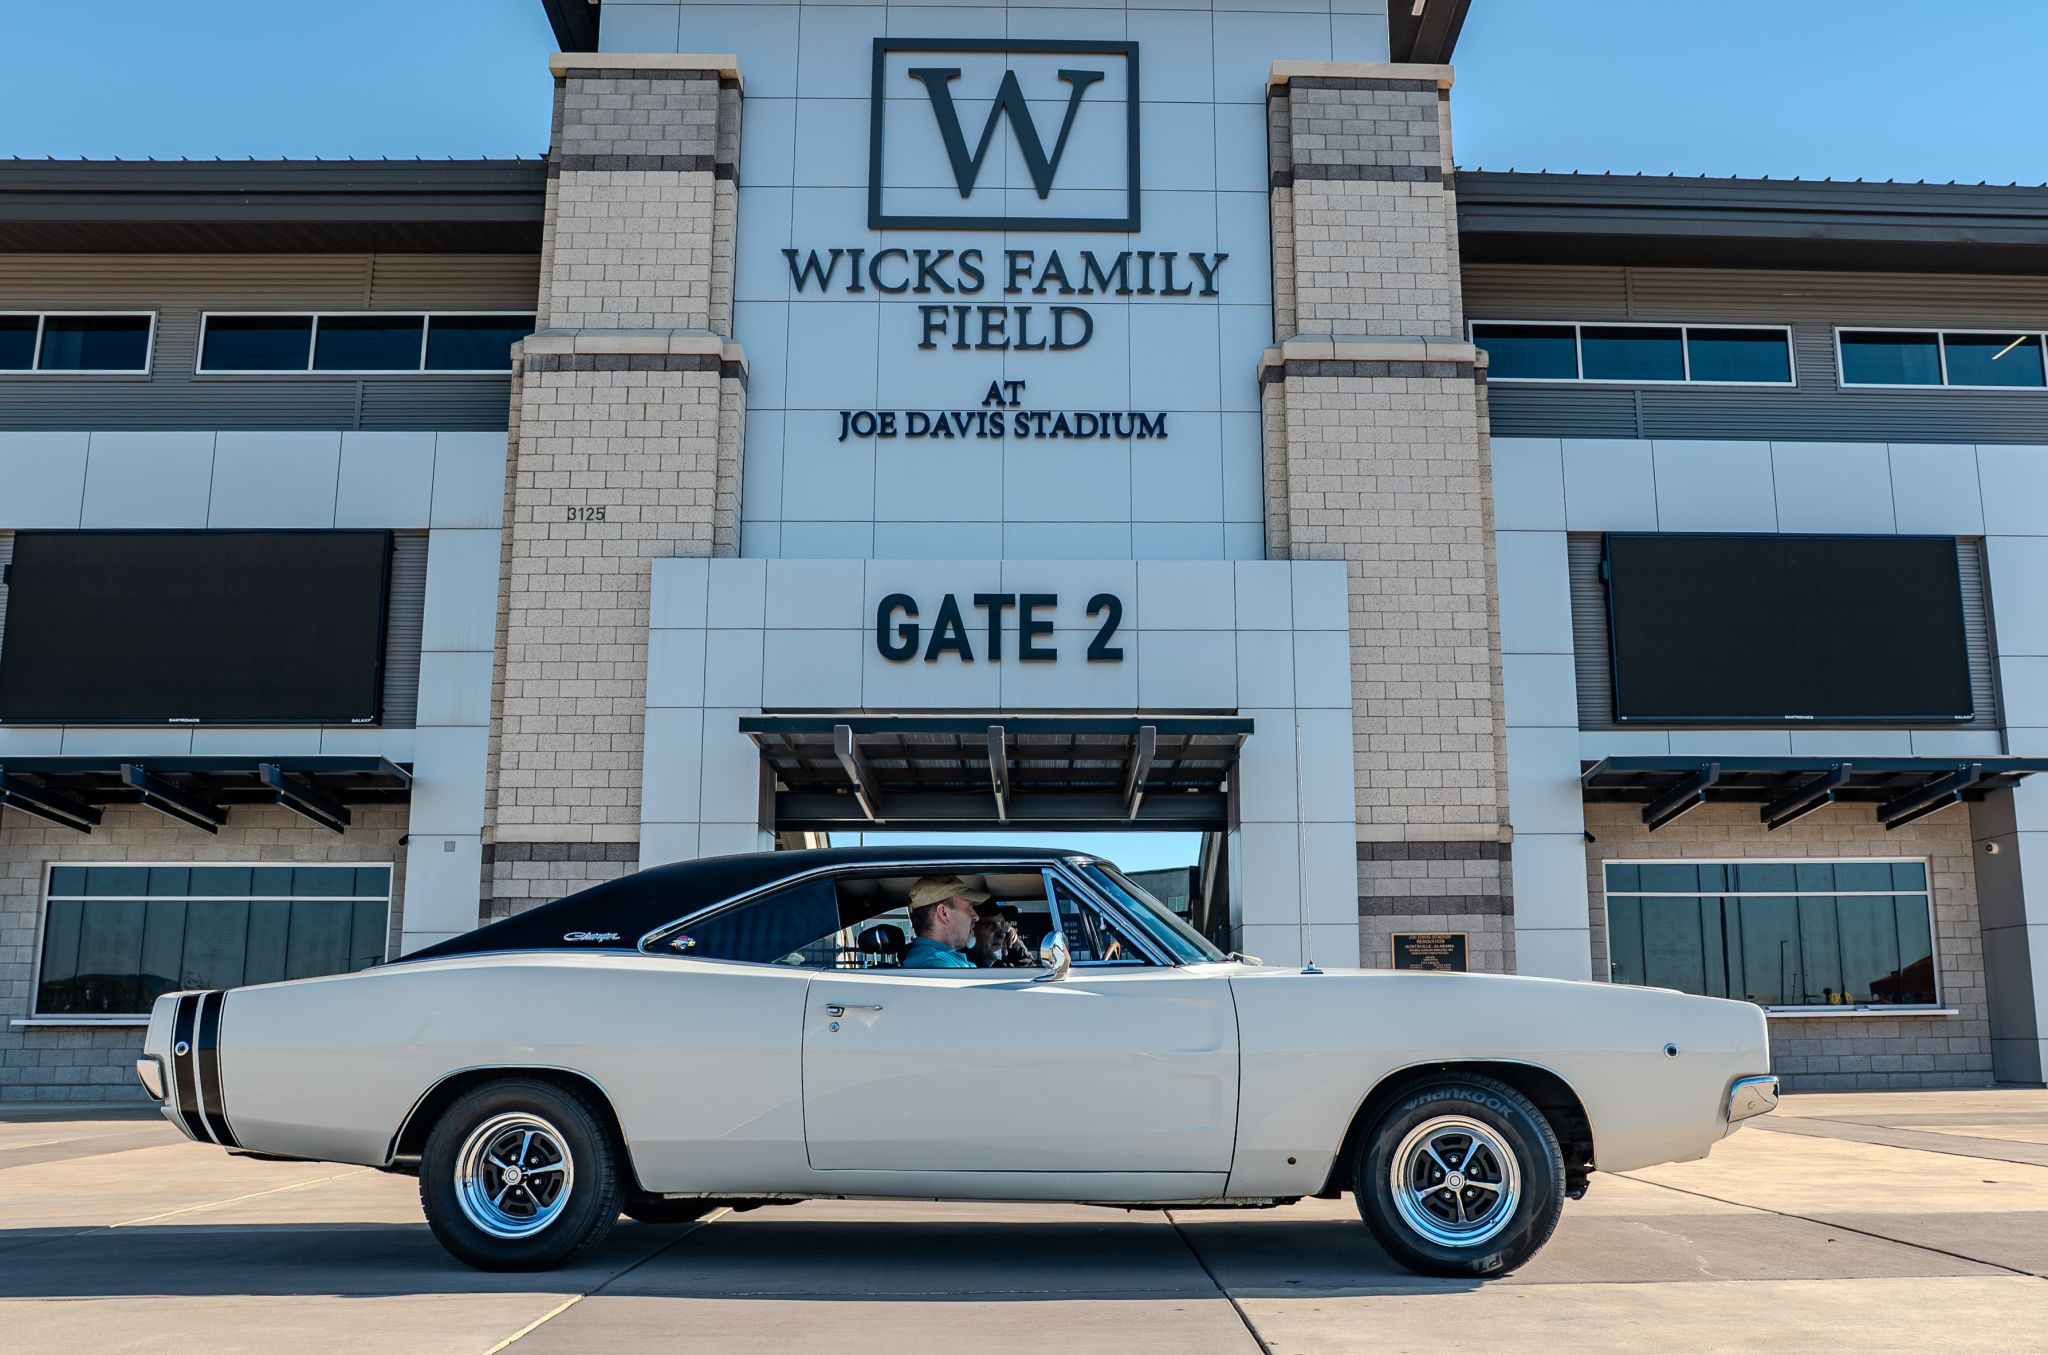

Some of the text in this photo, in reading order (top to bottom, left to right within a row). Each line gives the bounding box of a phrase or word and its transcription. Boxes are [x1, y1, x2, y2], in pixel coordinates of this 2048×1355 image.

[908, 67, 1104, 199] W
[781, 248, 1229, 296] WICKS FAMILY
[917, 304, 1094, 350] FIELD
[981, 380, 1026, 406] AT
[838, 411, 1168, 441] JOE DAVIS STADIUM
[568, 507, 605, 521] 3125
[876, 593, 1123, 662] GATE 2
